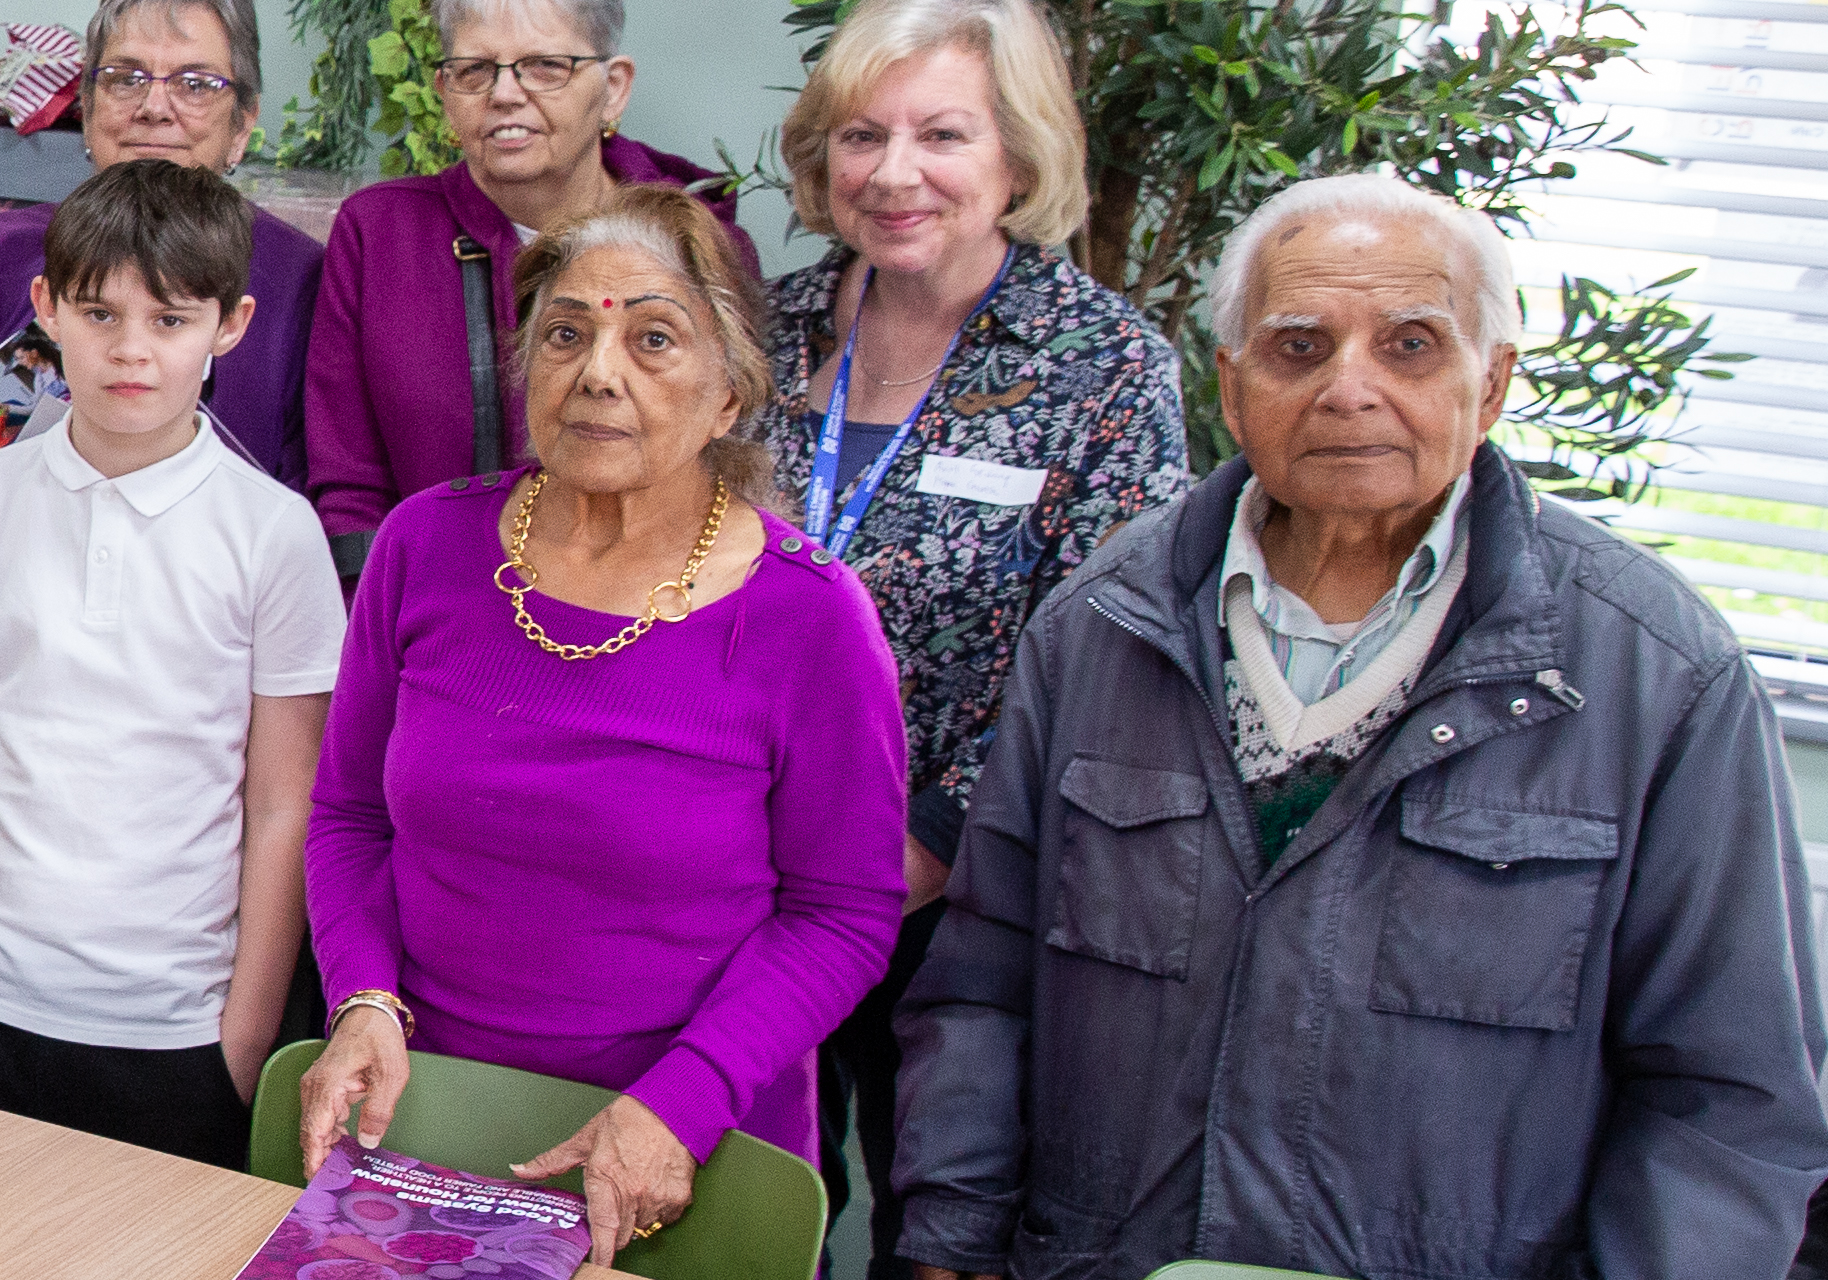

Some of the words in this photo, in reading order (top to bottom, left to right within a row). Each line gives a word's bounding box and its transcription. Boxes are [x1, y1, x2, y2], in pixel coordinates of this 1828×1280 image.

[350, 1168, 461, 1200] Hounslow
[395, 1190, 493, 1213] Systems
[461, 1190, 496, 1206] for
[494, 1205, 554, 1223] Food
[499, 1198, 582, 1223] Review
[557, 1217, 576, 1229] A
